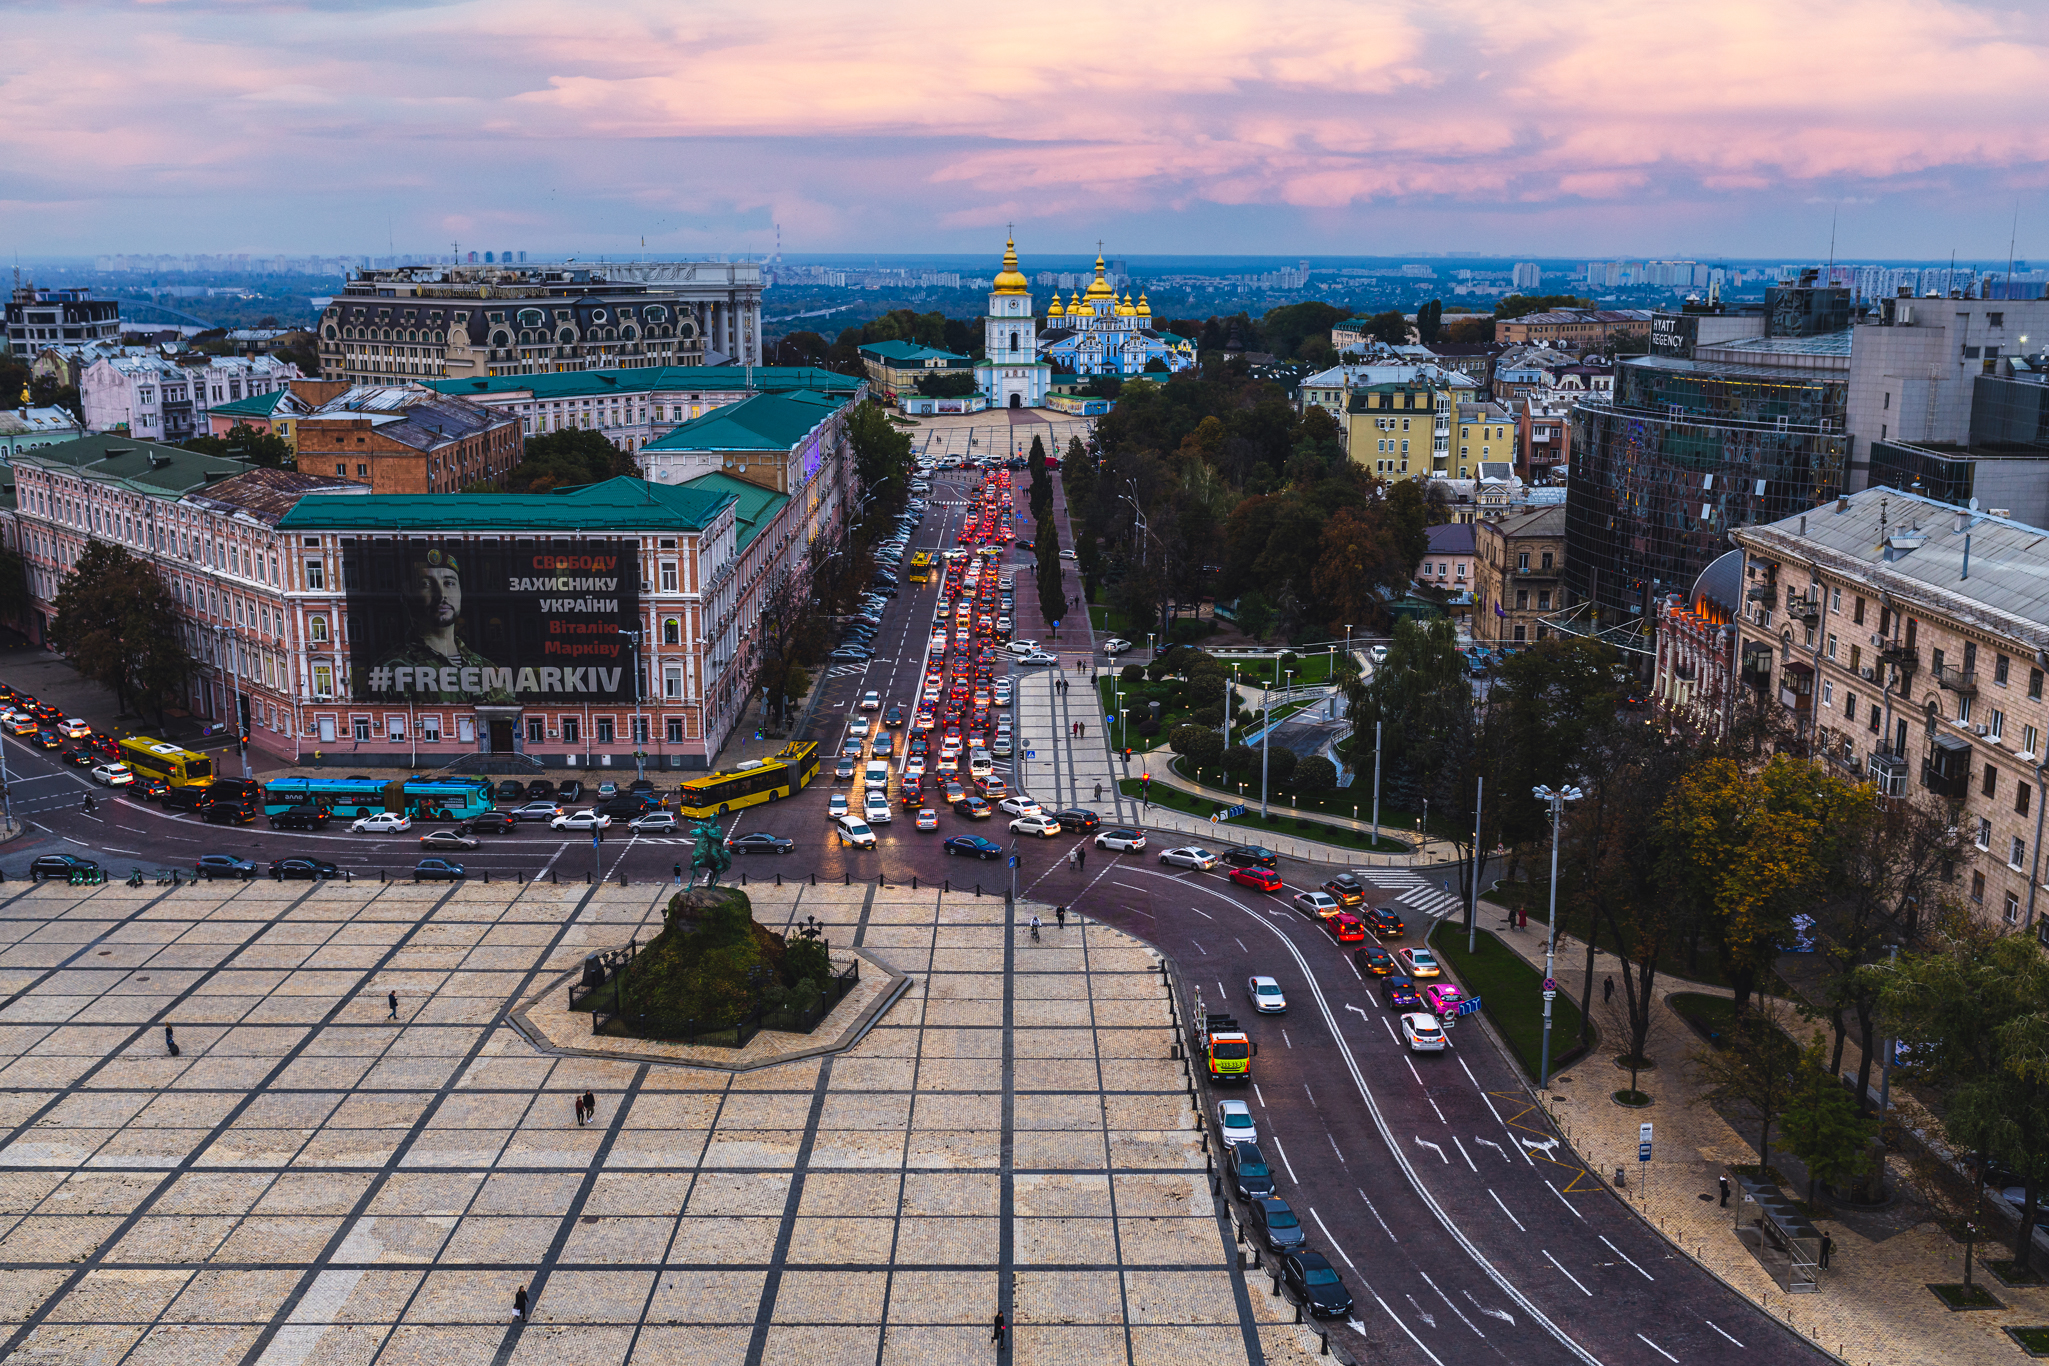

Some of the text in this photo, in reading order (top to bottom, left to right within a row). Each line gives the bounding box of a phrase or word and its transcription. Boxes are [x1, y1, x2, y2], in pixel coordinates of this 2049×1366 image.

[1653, 318, 1676, 332] HYATT
[1652, 332, 1684, 347] REGENCY
[532, 555, 617, 572] СВОБОДУ
[509, 577, 618, 591] ЗАХИСНИКУ
[539, 595, 619, 613] УКРАЇНИ
[549, 620, 619, 634] Віталію
[544, 640, 620, 658] Марківу
[368, 667, 622, 693] #FREEMARKIV
